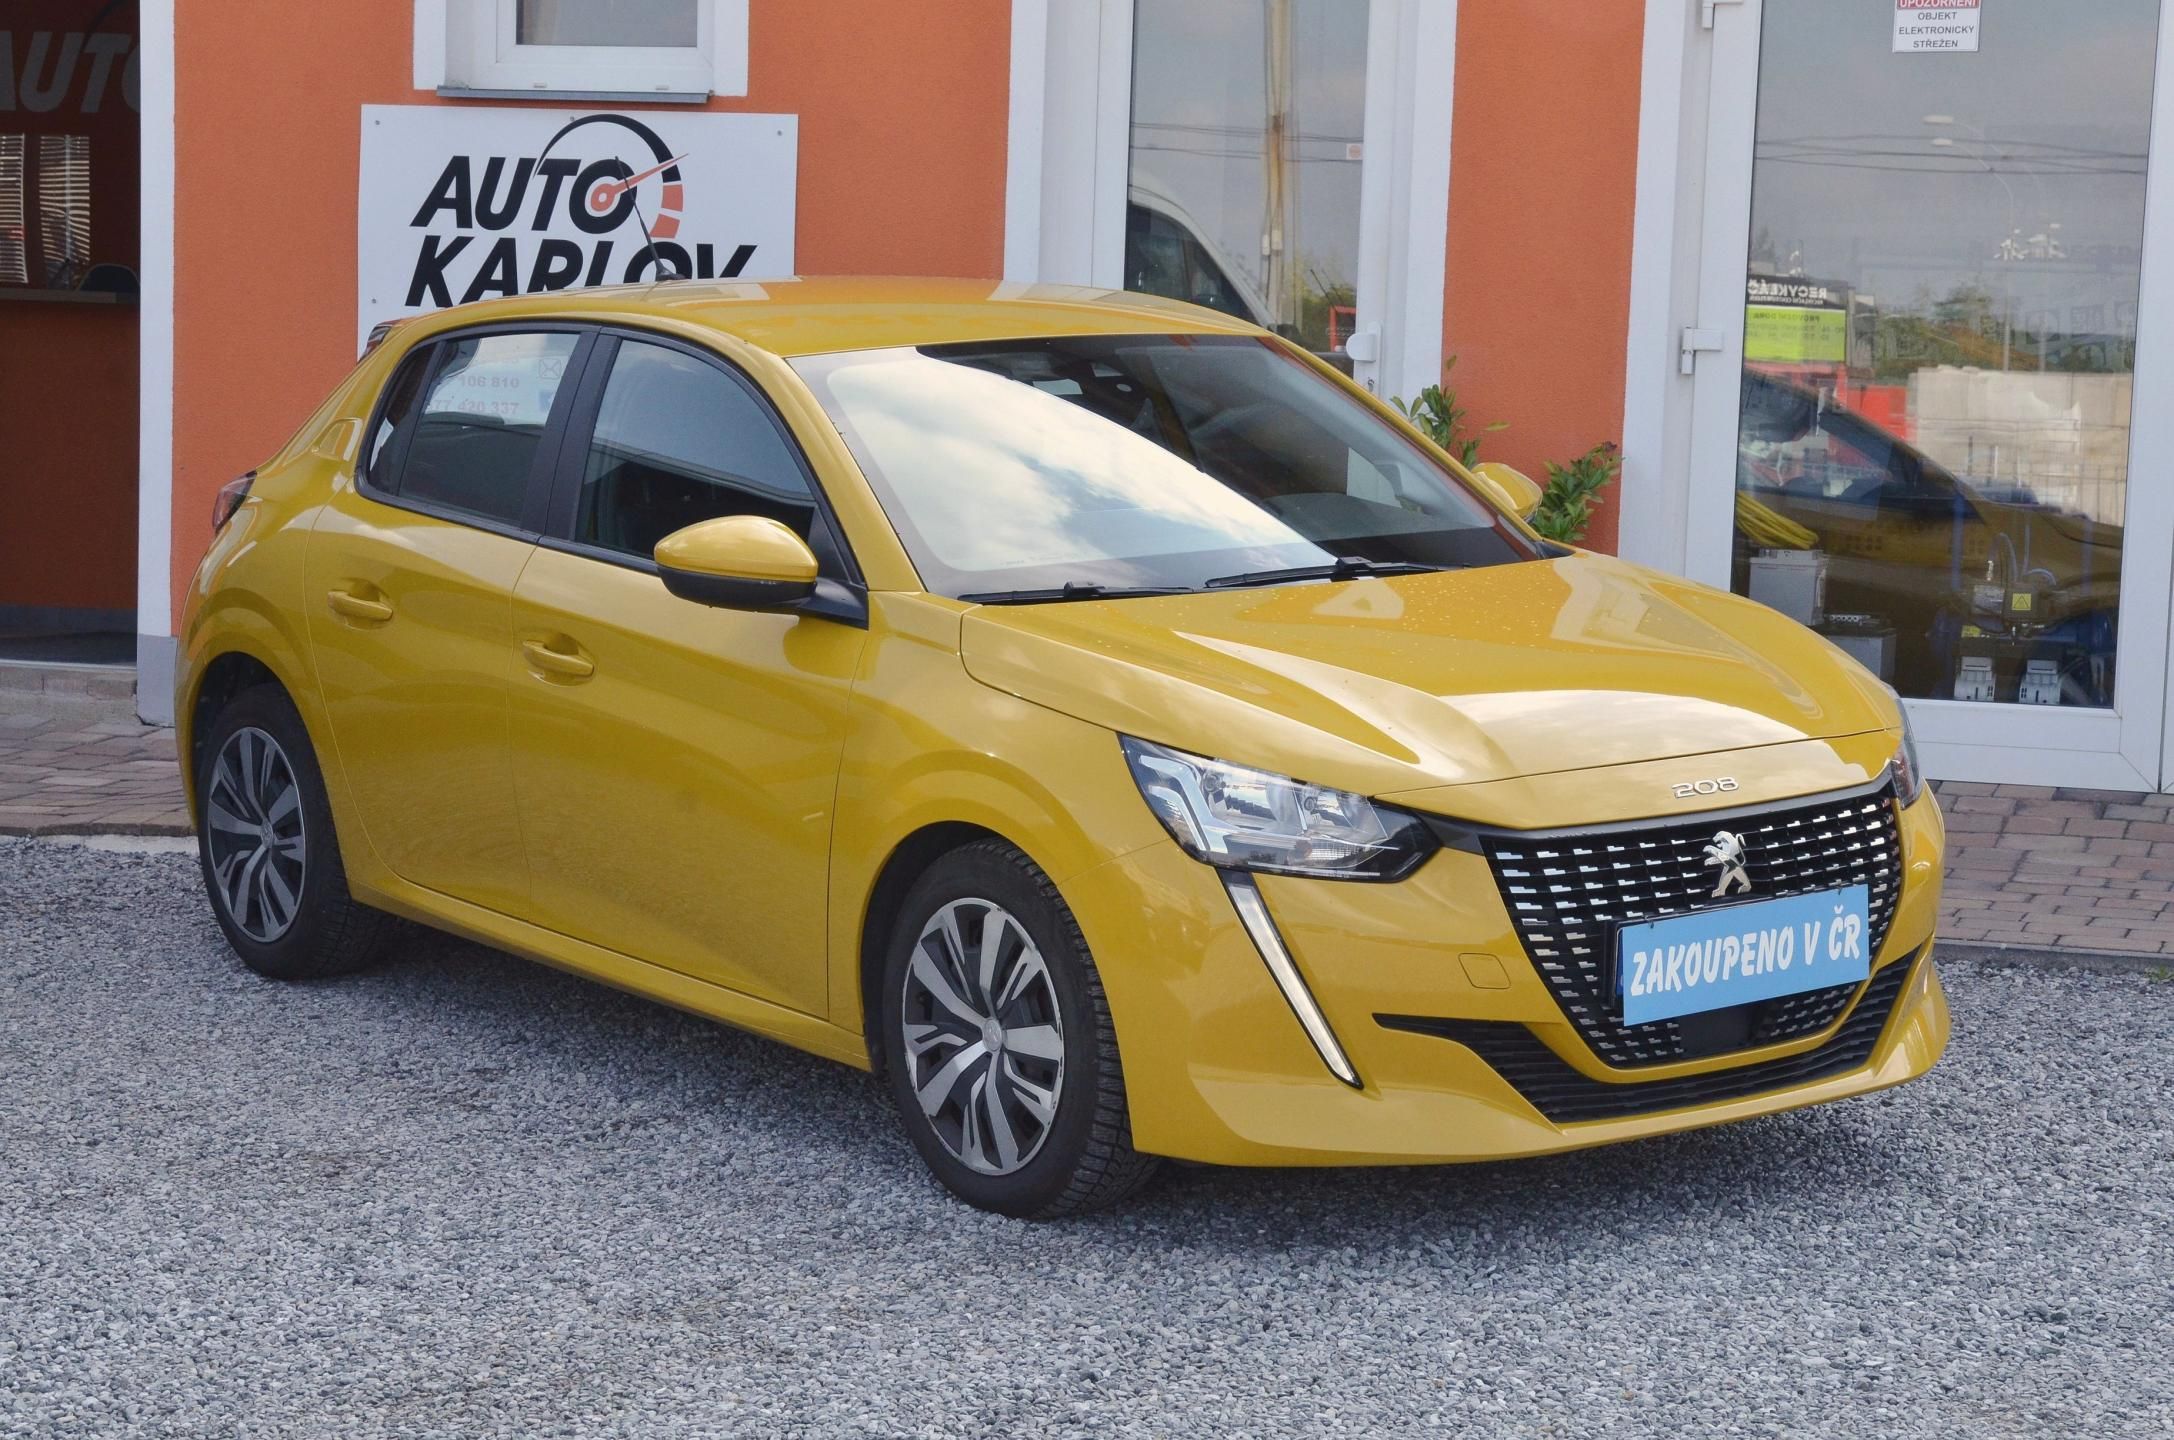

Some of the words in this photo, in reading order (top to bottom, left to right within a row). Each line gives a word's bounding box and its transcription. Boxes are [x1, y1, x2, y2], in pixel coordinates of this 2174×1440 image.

[1917, 11, 1957, 21] OBJEKT
[1898, 25, 1975, 35] ELEKTRONICKY
[1913, 38, 1959, 48] STŘEŽEN
[0, 29, 140, 113] UT
[409, 155, 638, 234] AUTO
[1671, 777, 1740, 798] 208
[1631, 925, 1795, 997] ZAKOUPENO
[1804, 920, 1821, 965] V
[1828, 904, 1861, 961] ČR
